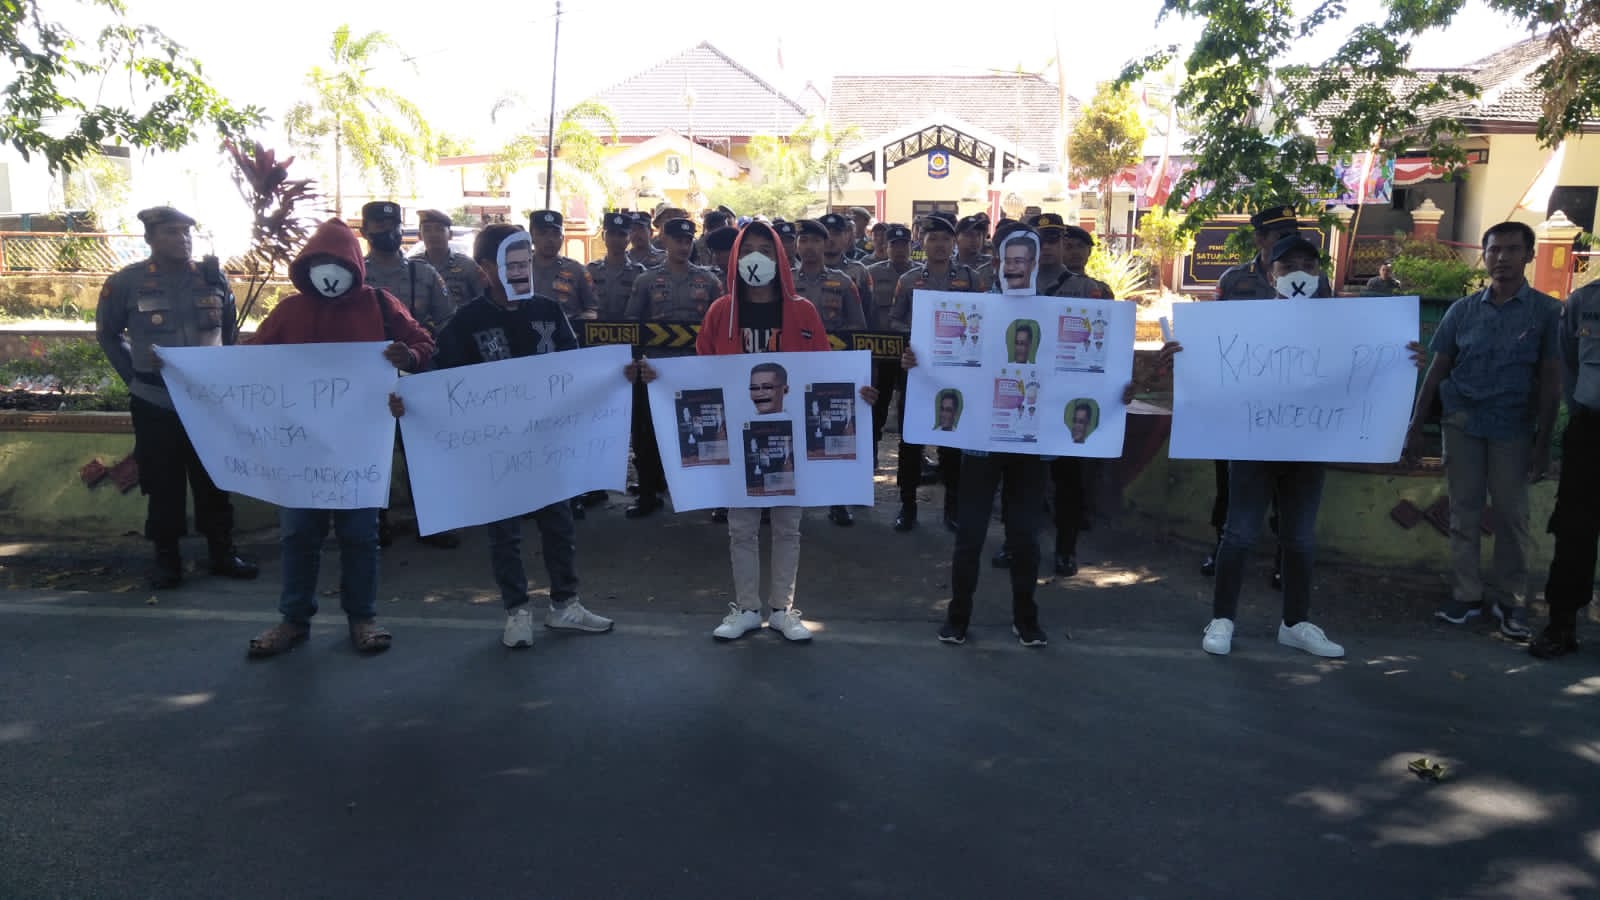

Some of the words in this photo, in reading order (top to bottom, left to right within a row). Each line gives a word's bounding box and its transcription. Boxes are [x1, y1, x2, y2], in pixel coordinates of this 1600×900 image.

[589, 326, 636, 343] POLISI
[856, 336, 902, 355] POLISI
[310, 377, 351, 409] PP
[547, 372, 575, 397] PP
